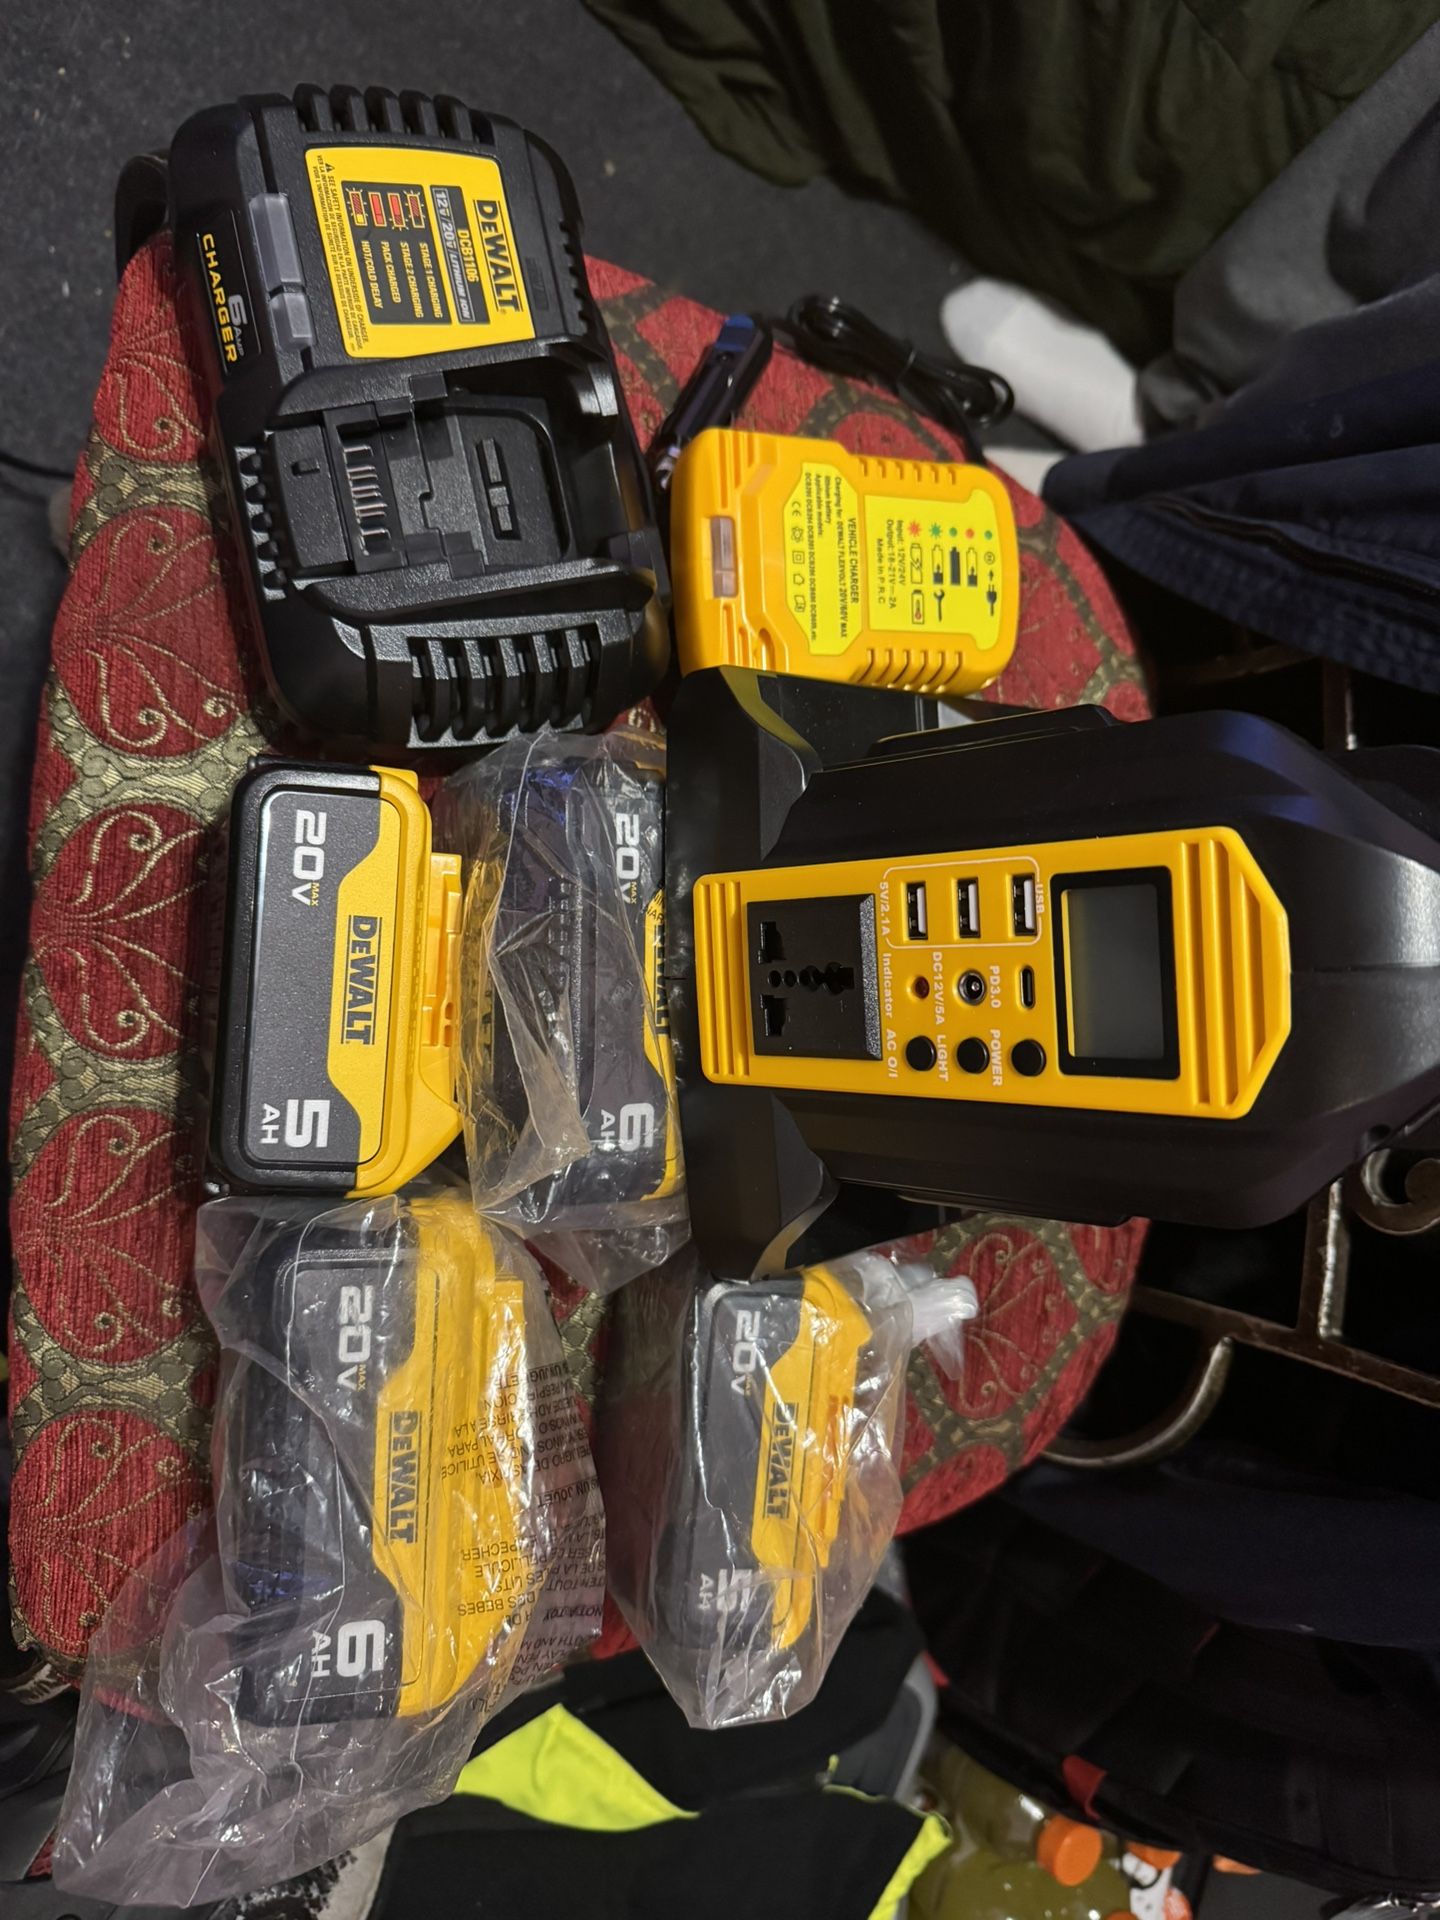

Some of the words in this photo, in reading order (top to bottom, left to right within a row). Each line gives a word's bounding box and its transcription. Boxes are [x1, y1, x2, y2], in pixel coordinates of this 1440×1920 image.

[328, 176, 336, 188] SEE
[330, 189, 340, 211] SAFETY
[336, 212, 350, 256] INFORMATION
[457, 229, 478, 282] DCB1106
[348, 268, 360, 304] UNDERSIDE
[361, 241, 377, 280] HOT/COLD
[370, 282, 384, 309] DELAY
[380, 241, 392, 263] PACK
[386, 264, 402, 303] CHARGED
[400, 242, 414, 269] STAGE
[407, 276, 424, 318] CHARGING
[419, 242, 432, 269] STAGE
[426, 276, 443, 318] CHARGING
[202, 233, 238, 362] CHARGER
[228, 294, 248, 326] 6
[848, 518, 858, 557] VEHICLE
[850, 559, 859, 603] CHARGER
[898, 548, 906, 586] 12V/24V
[291, 809, 327, 906] 20V
[311, 882, 320, 906] MAX
[614, 813, 640, 904] 20V
[879, 882, 890, 936] 5V/2.1A
[1035, 883, 1044, 913] USB
[882, 953, 894, 1018] Indicator
[933, 952, 946, 1025] DC12V/5A
[989, 966, 1001, 1008] PD3.0
[886, 1029, 897, 1051] AC
[936, 1034, 948, 1082] LIGHT
[990, 1029, 1002, 1086] POWER
[260, 1103, 281, 1144] AH
[284, 1099, 331, 1148] 5
[620, 1103, 654, 1152] 6
[337, 1285, 374, 1392] 20V
[357, 1364, 366, 1391] MAX
[730, 1310, 761, 1397] 20V
[447, 1438, 478, 1458] PARA
[538, 1486, 573, 1508] JOUET
[458, 1599, 504, 1616] BEBES
[310, 1630, 331, 1677] AH
[336, 1619, 386, 1678] 6
